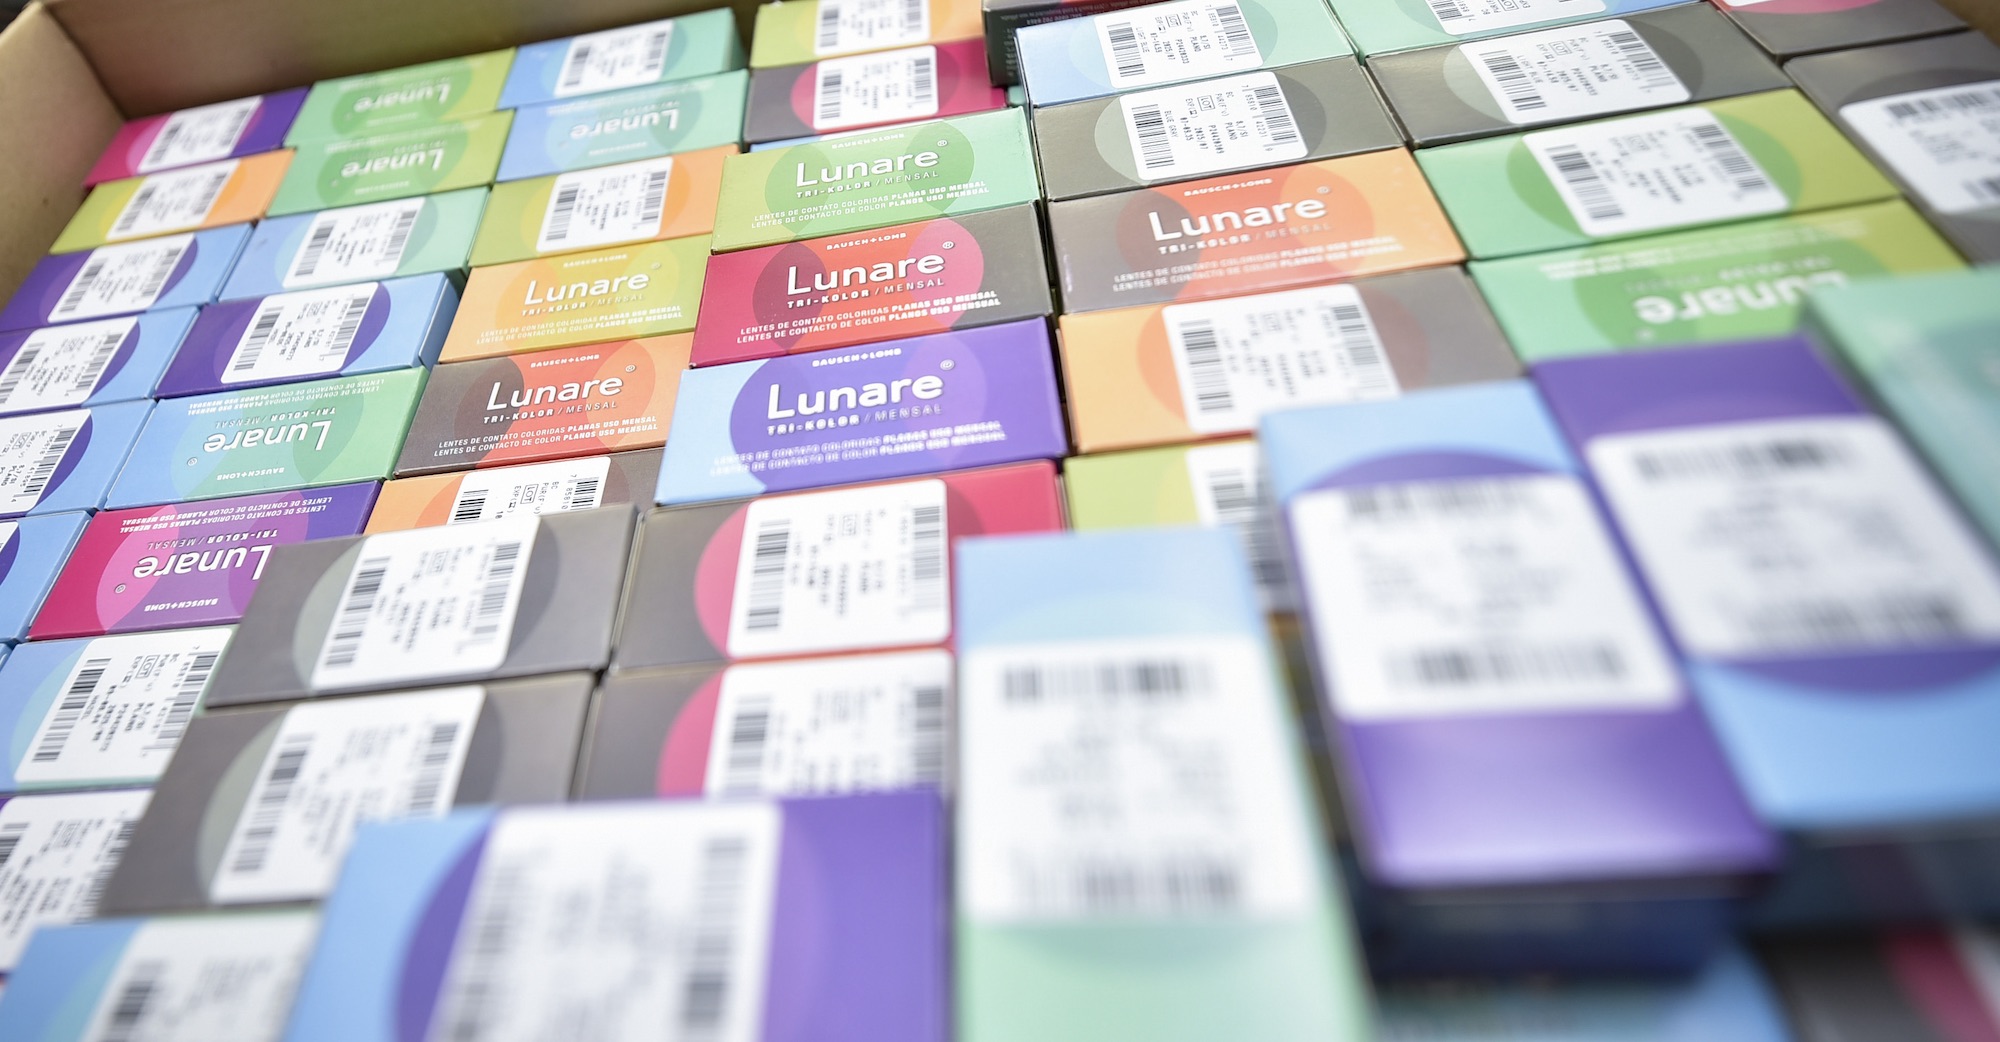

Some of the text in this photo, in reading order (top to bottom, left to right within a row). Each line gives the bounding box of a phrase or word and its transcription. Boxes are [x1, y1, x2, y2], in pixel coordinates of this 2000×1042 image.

[1552, 43, 1569, 54] LOT
[1200, 97, 1212, 109] LOT
[569, 108, 681, 139] Lunare
[1224, 122, 1239, 140] PLANO
[831, 133, 904, 149] BAUSCH+LOMB
[340, 149, 444, 177] Lunare
[796, 151, 939, 187] Lunare
[796, 170, 938, 199] TRI-KOLOR MENSAL
[751, 218, 783, 228] LENTES
[798, 209, 842, 221] CONTACTO
[858, 202, 886, 212] COLOR
[888, 196, 924, 208] PLANOS
[925, 193, 944, 202] USO
[946, 186, 990, 199] MENSUAL
[754, 211, 786, 221] LENTES
[800, 203, 839, 214] CONTATO
[841, 195, 889, 208] COLORIDAS
[891, 189, 927, 200] PLANAS
[928, 186, 947, 195] USO
[948, 180, 987, 191] MENSAL
[1149, 199, 1327, 242] Lunare
[826, 232, 907, 250] BAUSCH+LOMB
[787, 255, 945, 296] Lunare
[524, 273, 649, 305] Lunare
[787, 277, 944, 309] TRI-KOLOR MENSAL
[522, 293, 644, 316] TRI-KOLOR MENSAL
[740, 323, 775, 335] LENTES
[791, 315, 834, 328] CONTATO
[836, 306, 889, 321] COLORIDAS
[891, 300, 931, 313] PLANAS
[933, 297, 953, 306] USO
[955, 290, 997, 303] MENSAL
[737, 332, 772, 344] LENTES
[788, 322, 838, 336] CONTACTO
[855, 315, 886, 326] COLOR
[888, 309, 928, 321] PLANOS
[930, 305, 950, 315] USO
[952, 298, 1001, 312] MENSUAL
[530, 353, 599, 368] BAUSCH+LOMB
[486, 377, 623, 411] Lunare
[768, 376, 944, 420] Lunare
[484, 400, 617, 424] TRI-KOLOR MENSAL
[875, 403, 942, 421] MENSAL
[215, 417, 261, 430] MENSAL
[438, 438, 469, 448] LENTES
[482, 432, 519, 443] CONTATO
[520, 426, 566, 438] COLORIDAS
[567, 422, 601, 433] PLANAS
[602, 419, 620, 428] USO
[621, 415, 657, 426] MENSAL
[202, 420, 333, 453] Lunare
[433, 446, 464, 457] LENTES
[478, 439, 520, 452] CONTACTO
[534, 435, 561, 445] COLOR
[562, 430, 596, 441] PLANOS
[597, 428, 616, 437] USO
[616, 423, 658, 435] MENSUAL
[301, 496, 332, 506] LENTES
[523, 486, 535, 502] LOT
[176, 510, 208, 520] PLANOS
[208, 507, 234, 516] COLOR
[246, 509, 282, 520] CONTATO
[247, 500, 288, 512] CONTACTO
[295, 504, 327, 515] LENTES
[122, 515, 160, 526] MENSUAL
[152, 522, 169, 531] USO
[159, 513, 176, 522] USO
[169, 518, 202, 528] PLANAS
[201, 513, 245, 525] COLORIDAS
[120, 524, 152, 534] MENSAL
[148, 529, 278, 552] TRI-KOLOR MENSAL
[133, 544, 273, 580] Lunare
[139, 657, 156, 676] LOT
